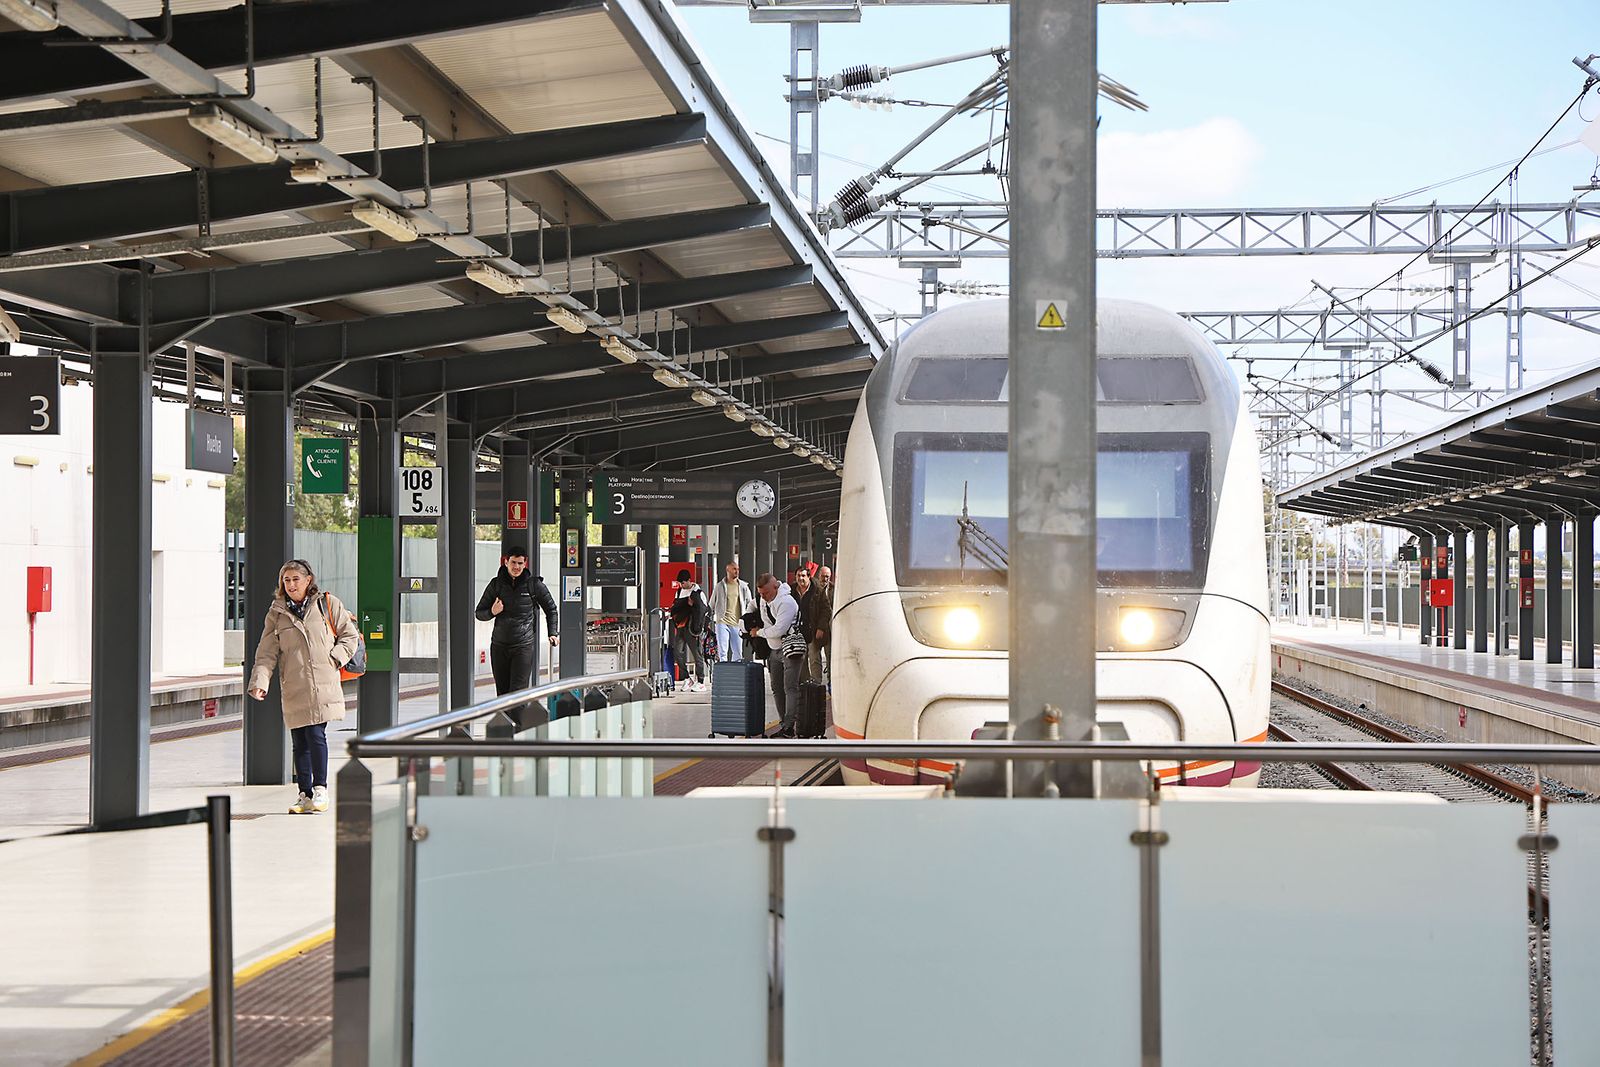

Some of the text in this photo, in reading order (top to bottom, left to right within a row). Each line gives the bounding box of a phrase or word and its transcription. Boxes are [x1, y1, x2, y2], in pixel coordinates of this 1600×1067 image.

[30, 395, 50, 431] 3
[206, 433, 222, 454] Huelva
[402, 469, 433, 490] 108
[412, 492, 438, 513] 5 494
[613, 492, 625, 515] 3
[825, 537, 833, 550] 3
[1400, 552, 1405, 560] 5
